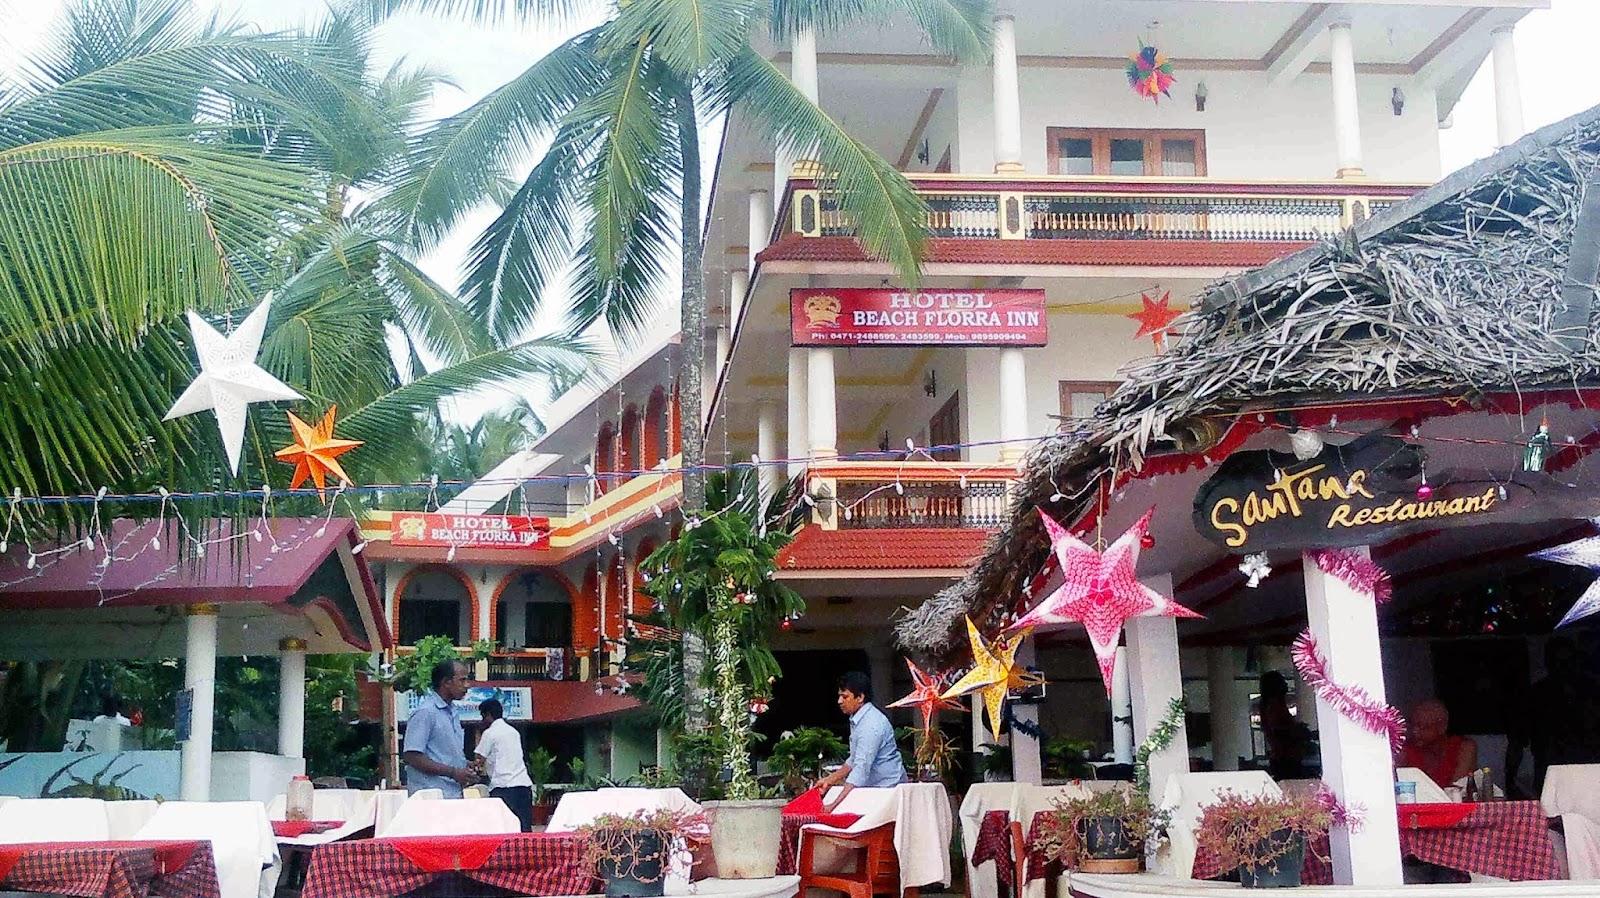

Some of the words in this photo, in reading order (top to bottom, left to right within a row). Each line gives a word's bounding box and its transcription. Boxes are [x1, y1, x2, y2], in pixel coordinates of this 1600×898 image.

[890, 293, 993, 309] HOTEL
[853, 310, 919, 327] BEACH
[924, 310, 1001, 327] FLORRA
[1007, 311, 1040, 327] INN
[1211, 464, 1374, 547] Santana
[1327, 487, 1496, 529] Restaurant
[453, 517, 512, 530] HOTEL
[431, 528, 470, 541] BEACH
[472, 530, 517, 542] FLORRA
